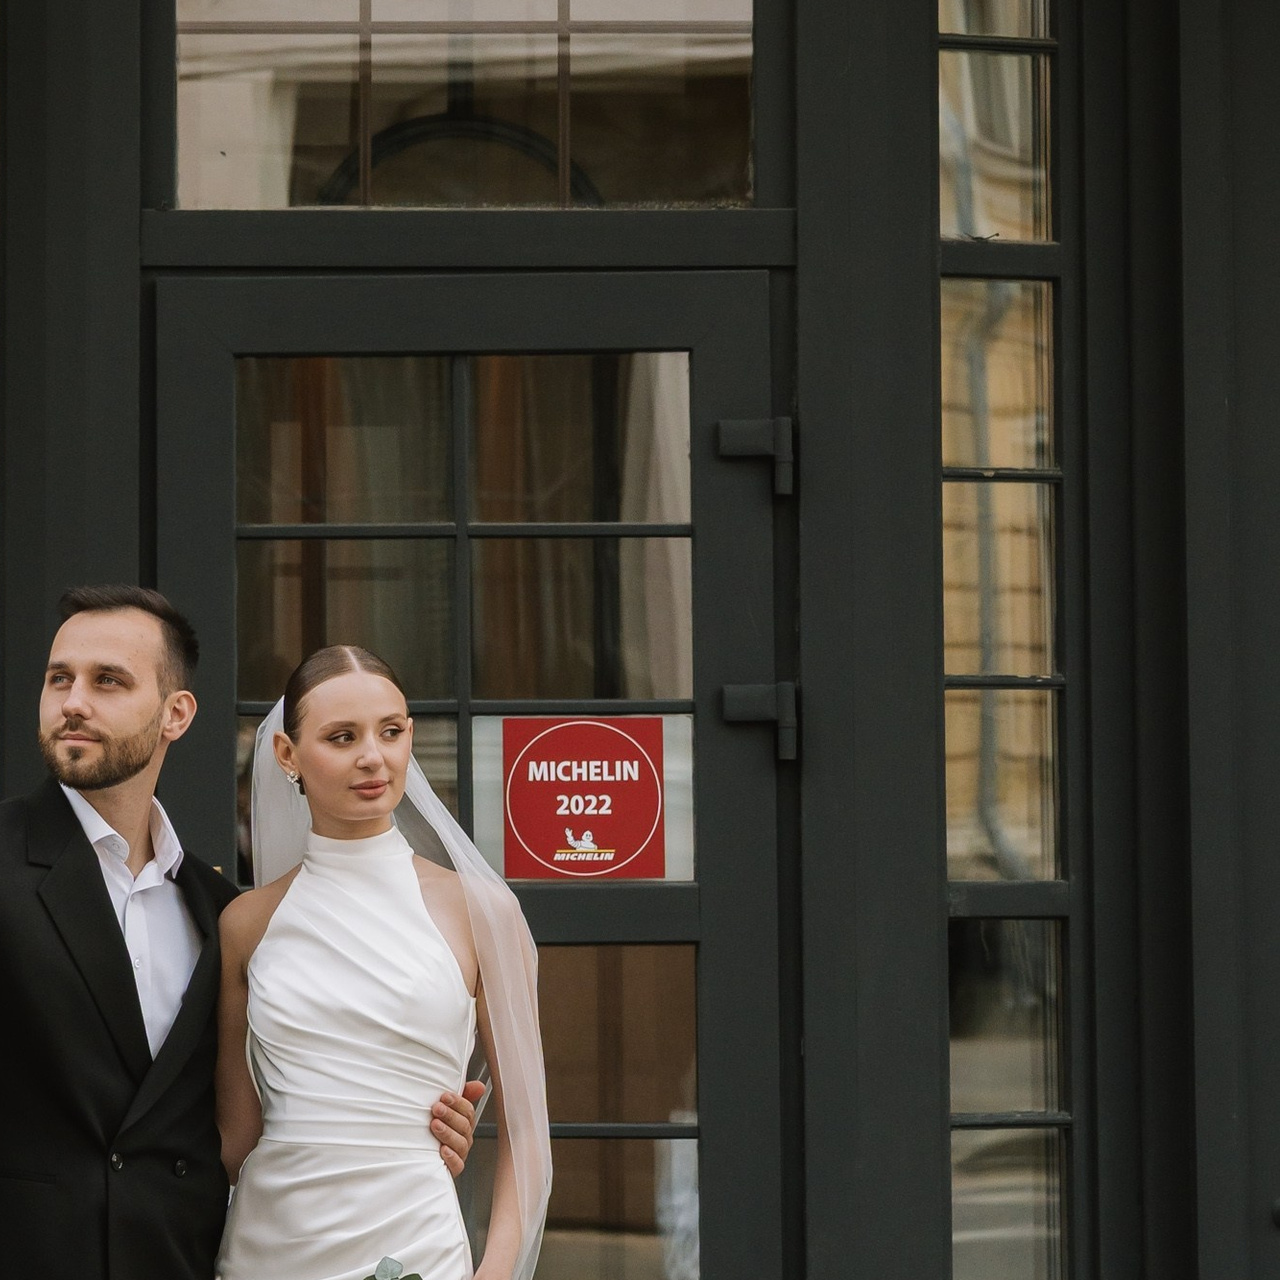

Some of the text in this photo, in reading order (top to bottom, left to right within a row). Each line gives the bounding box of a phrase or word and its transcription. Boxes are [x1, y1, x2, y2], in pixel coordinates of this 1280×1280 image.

[528, 761, 639, 782] MICHELIN
[556, 794, 612, 815] 2022
[553, 852, 616, 861] MICHELIN
